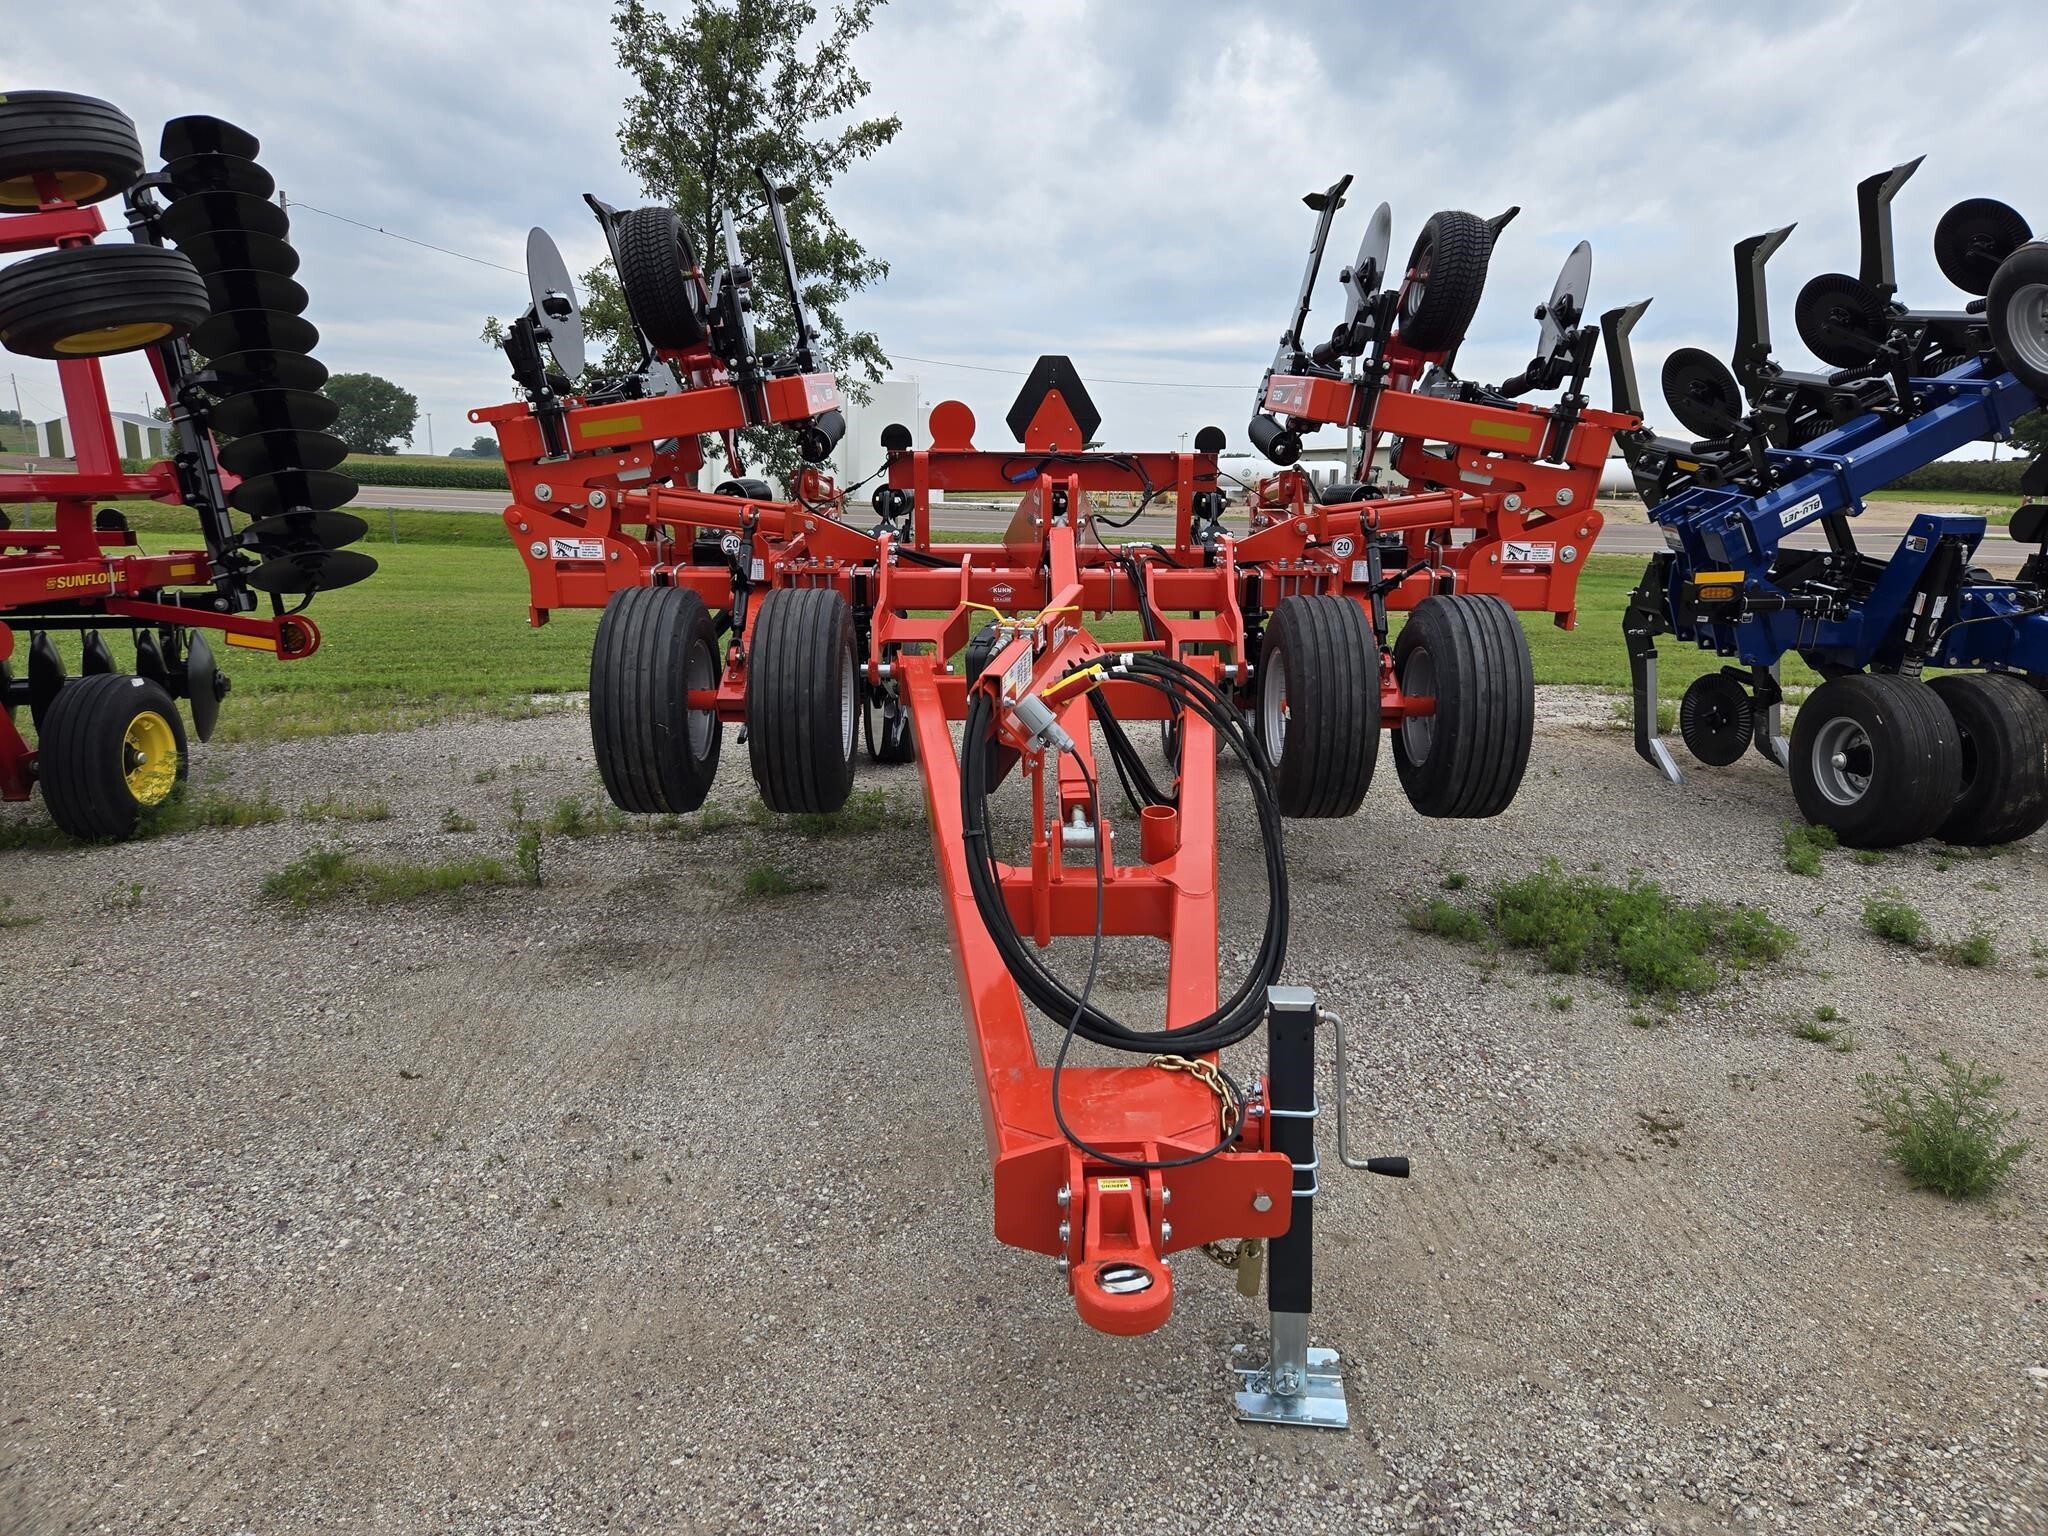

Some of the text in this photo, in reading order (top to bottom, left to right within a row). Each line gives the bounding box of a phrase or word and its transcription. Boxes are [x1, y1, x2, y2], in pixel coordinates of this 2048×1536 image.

[1783, 501, 1820, 524] BLU-JET
[726, 539, 738, 548] 20
[1337, 542, 1350, 551] 20
